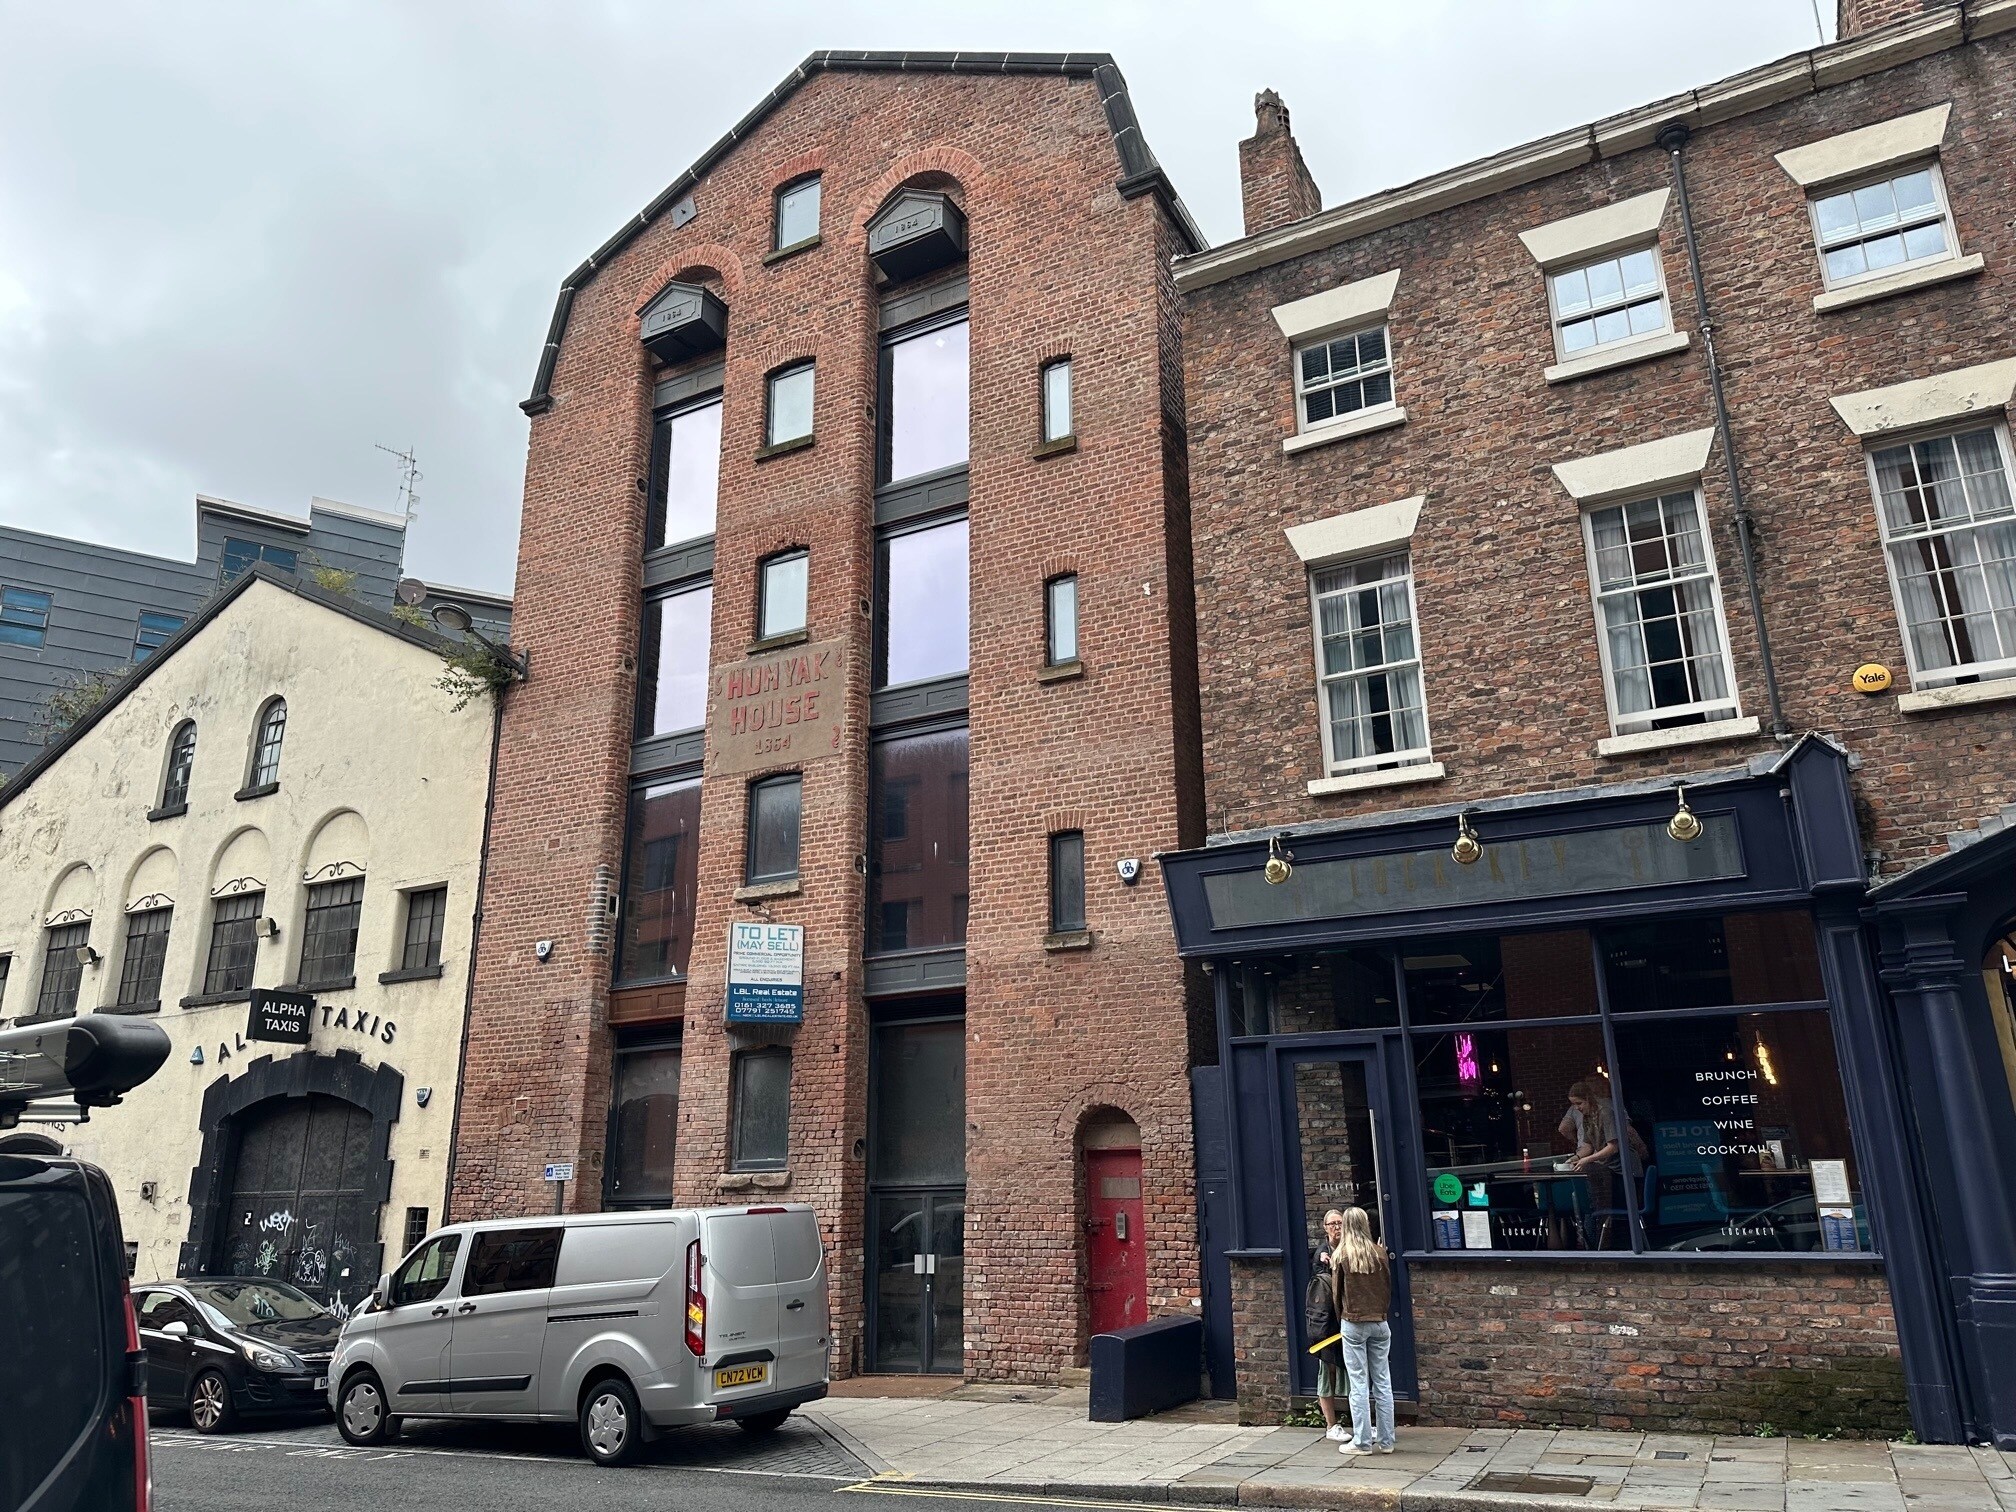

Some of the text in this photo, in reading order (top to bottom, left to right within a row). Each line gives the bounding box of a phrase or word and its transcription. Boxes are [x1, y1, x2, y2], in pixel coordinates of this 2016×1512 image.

[1860, 673, 1885, 684] Yale
[731, 691, 820, 735] HOUSE
[738, 926, 799, 941] TO LET
[737, 940, 799, 951] (MAY SELL)
[752, 988, 770, 996] Real
[771, 988, 798, 996] Estate
[262, 1001, 306, 1017] ALPHA
[265, 1018, 300, 1033] TAXIS
[321, 1005, 397, 1044] TAXIS
[1695, 1070, 1758, 1082] BRUNCH
[1702, 1094, 1759, 1106] COFFEE
[1713, 1119, 1754, 1130] WINE
[1697, 1144, 1780, 1156] COCKTAILS
[1502, 1227, 1525, 1236] LOCK
[1532, 1227, 1549, 1236] KEY
[1721, 1227, 1747, 1236] LOCK
[1755, 1227, 1775, 1236] KEY
[720, 1370, 744, 1384] CN72
